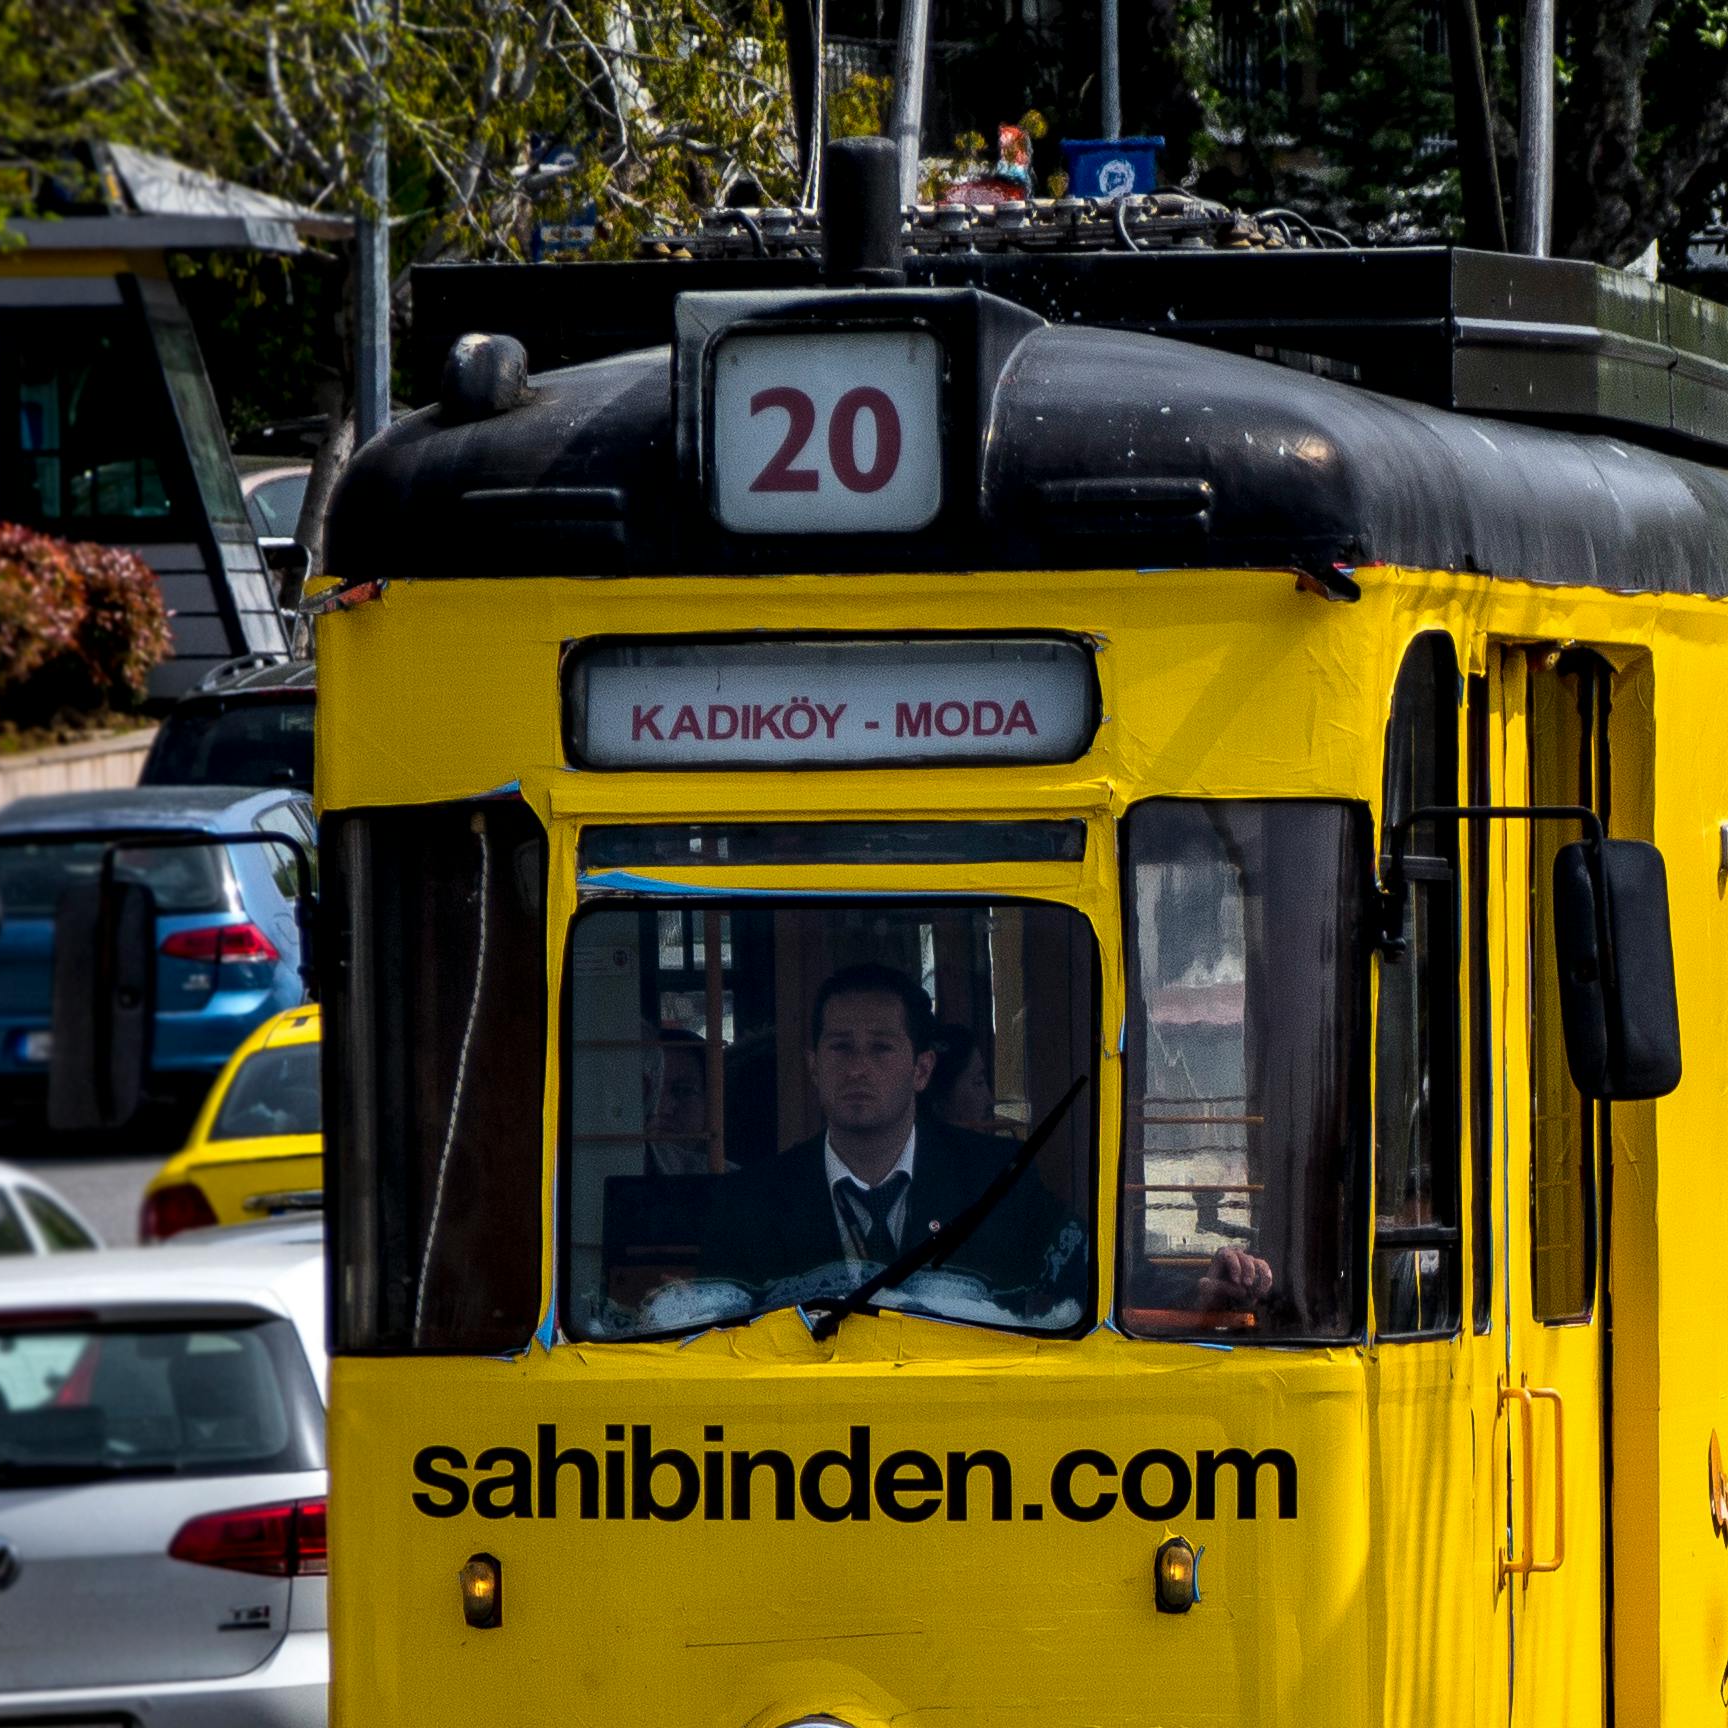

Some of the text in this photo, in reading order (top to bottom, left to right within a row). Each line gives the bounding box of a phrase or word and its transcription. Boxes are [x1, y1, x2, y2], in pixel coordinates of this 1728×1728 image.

[749, 386, 901, 493] 20
[632, 696, 847, 741] KADIKÖY
[895, 700, 1038, 738] MODA
[411, 1424, 1298, 1522] sahibinden.com
